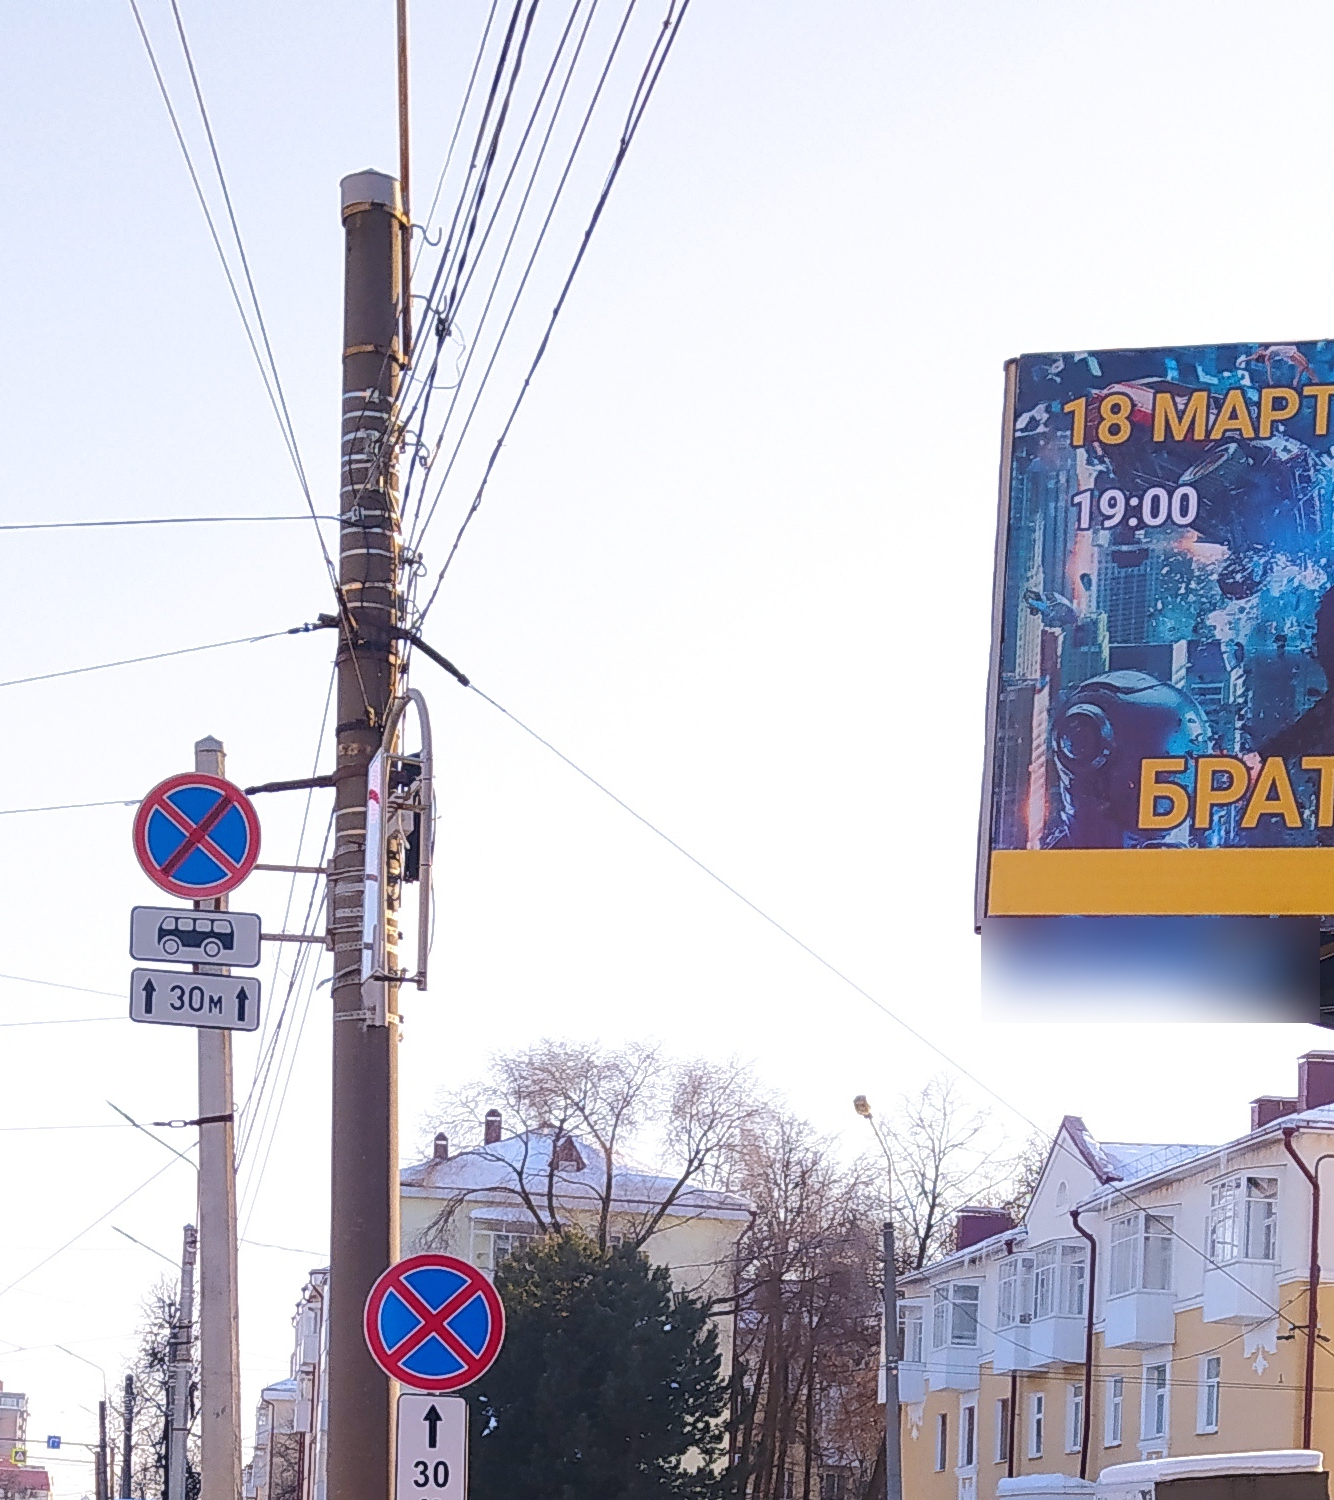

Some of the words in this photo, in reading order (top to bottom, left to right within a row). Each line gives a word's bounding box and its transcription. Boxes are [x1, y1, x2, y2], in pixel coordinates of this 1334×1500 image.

[1063, 393, 1134, 447] 18
[1072, 485, 1200, 531] 19:00
[412, 1460, 450, 1488] 30
